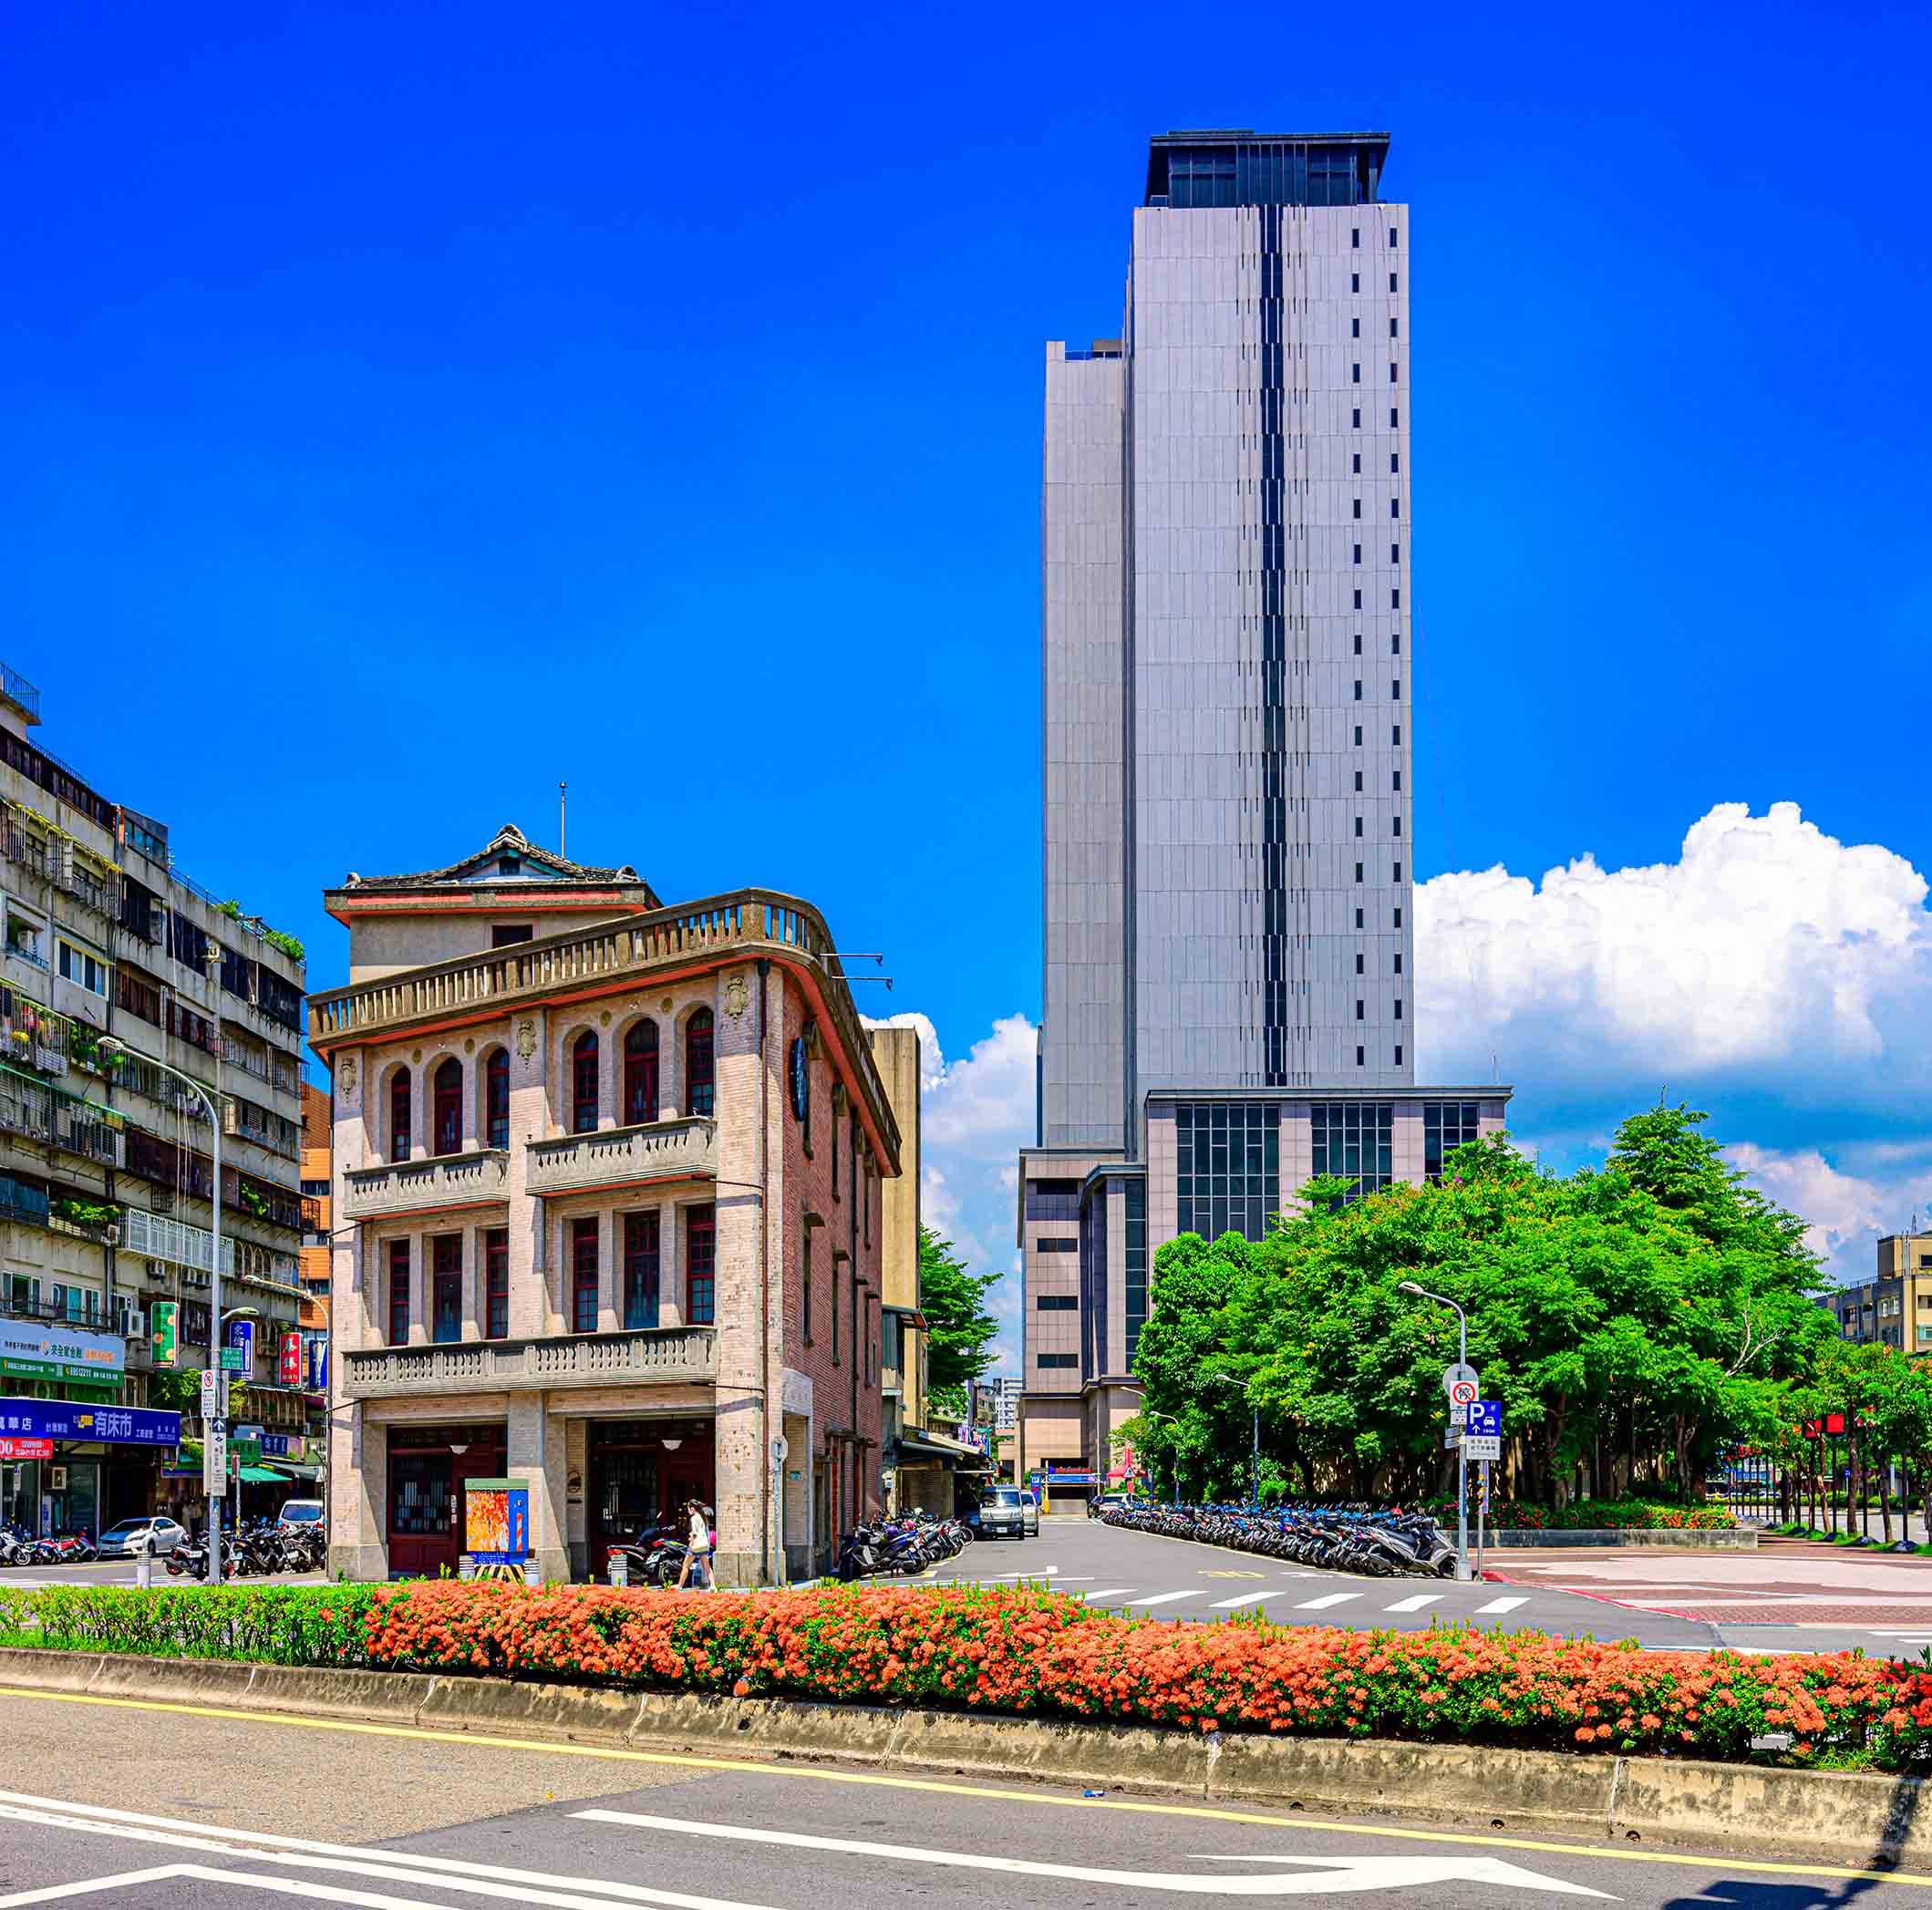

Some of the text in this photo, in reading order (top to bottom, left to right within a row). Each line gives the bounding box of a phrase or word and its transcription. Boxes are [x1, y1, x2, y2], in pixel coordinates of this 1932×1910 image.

[95, 1411, 132, 1438] 有床市
[1470, 1403, 1485, 1424] P
